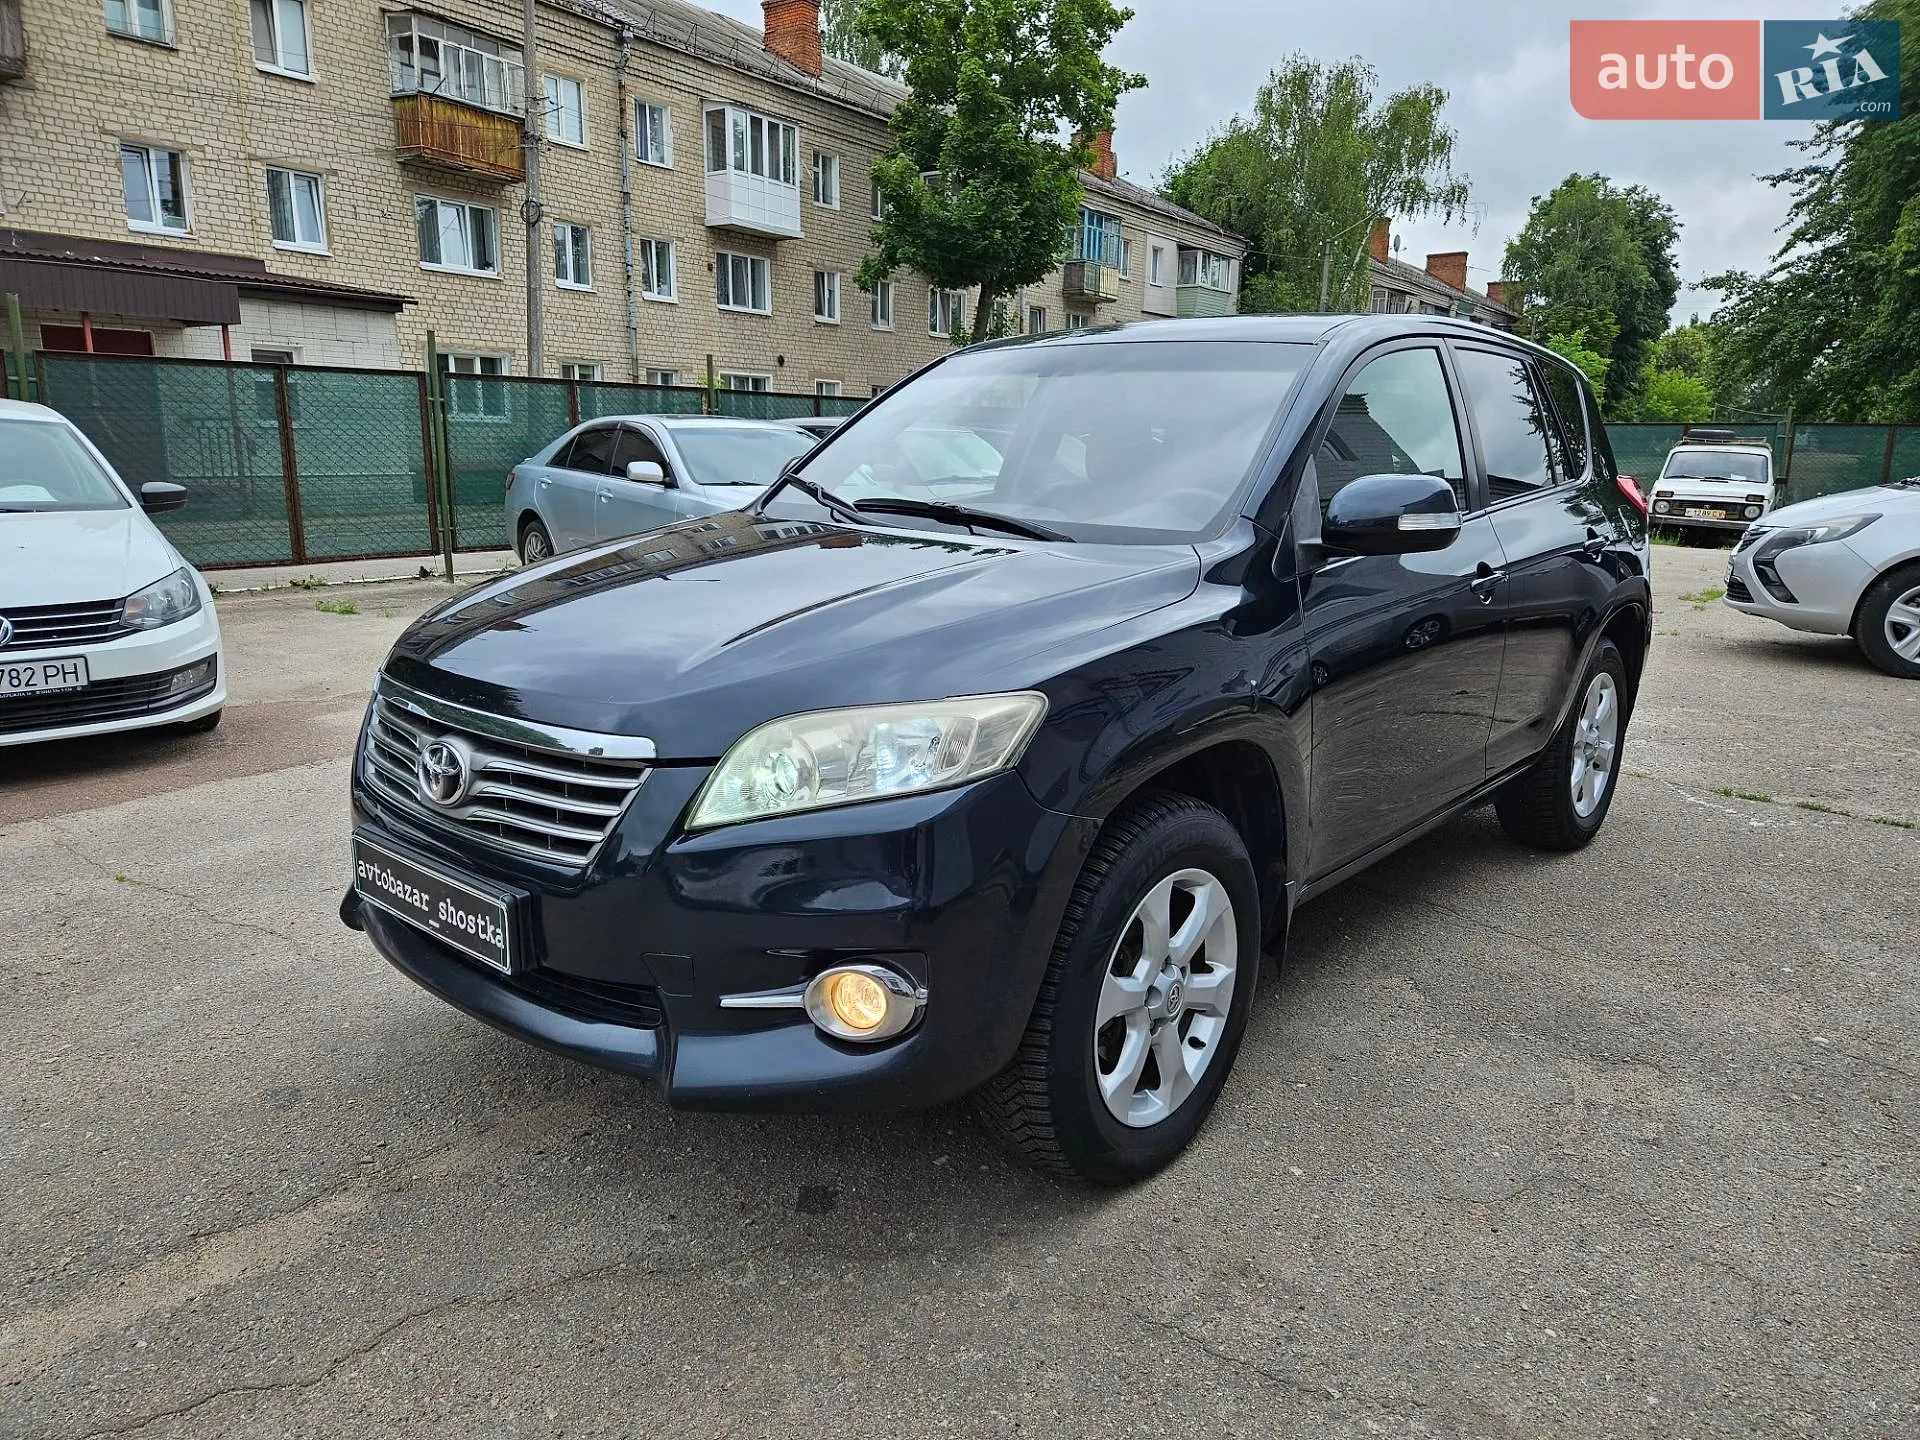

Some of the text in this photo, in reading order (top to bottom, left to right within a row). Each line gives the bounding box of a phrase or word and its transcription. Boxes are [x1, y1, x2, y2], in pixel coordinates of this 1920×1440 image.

[0, 663, 79, 687] 782 PH
[358, 859, 504, 949] avtobazar_shostka
